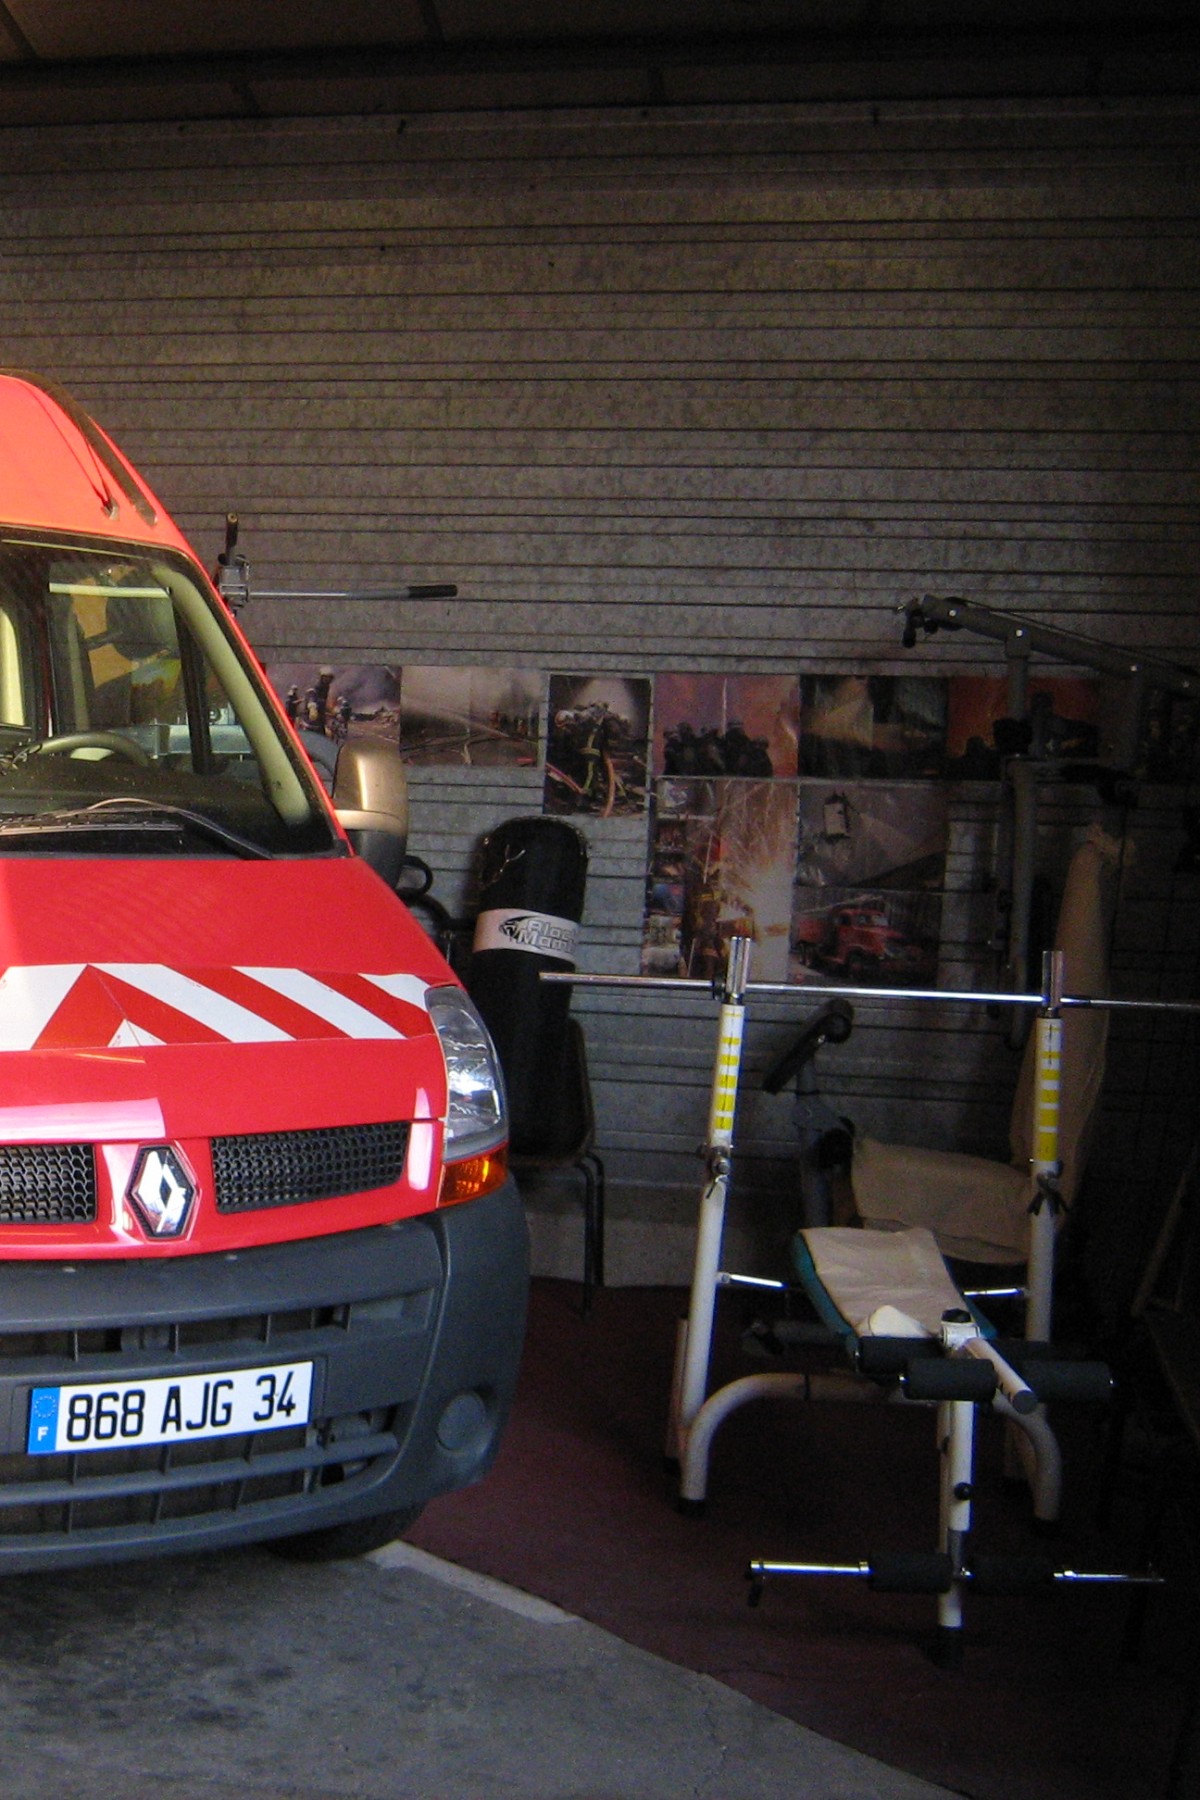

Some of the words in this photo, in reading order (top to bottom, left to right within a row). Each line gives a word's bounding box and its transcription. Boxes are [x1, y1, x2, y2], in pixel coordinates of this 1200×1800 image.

[517, 928, 576, 954] Mamb
[66, 1389, 146, 1442] 868
[160, 1379, 234, 1434] AJG
[252, 1371, 296, 1421] 34
[37, 1426, 49, 1442] F
